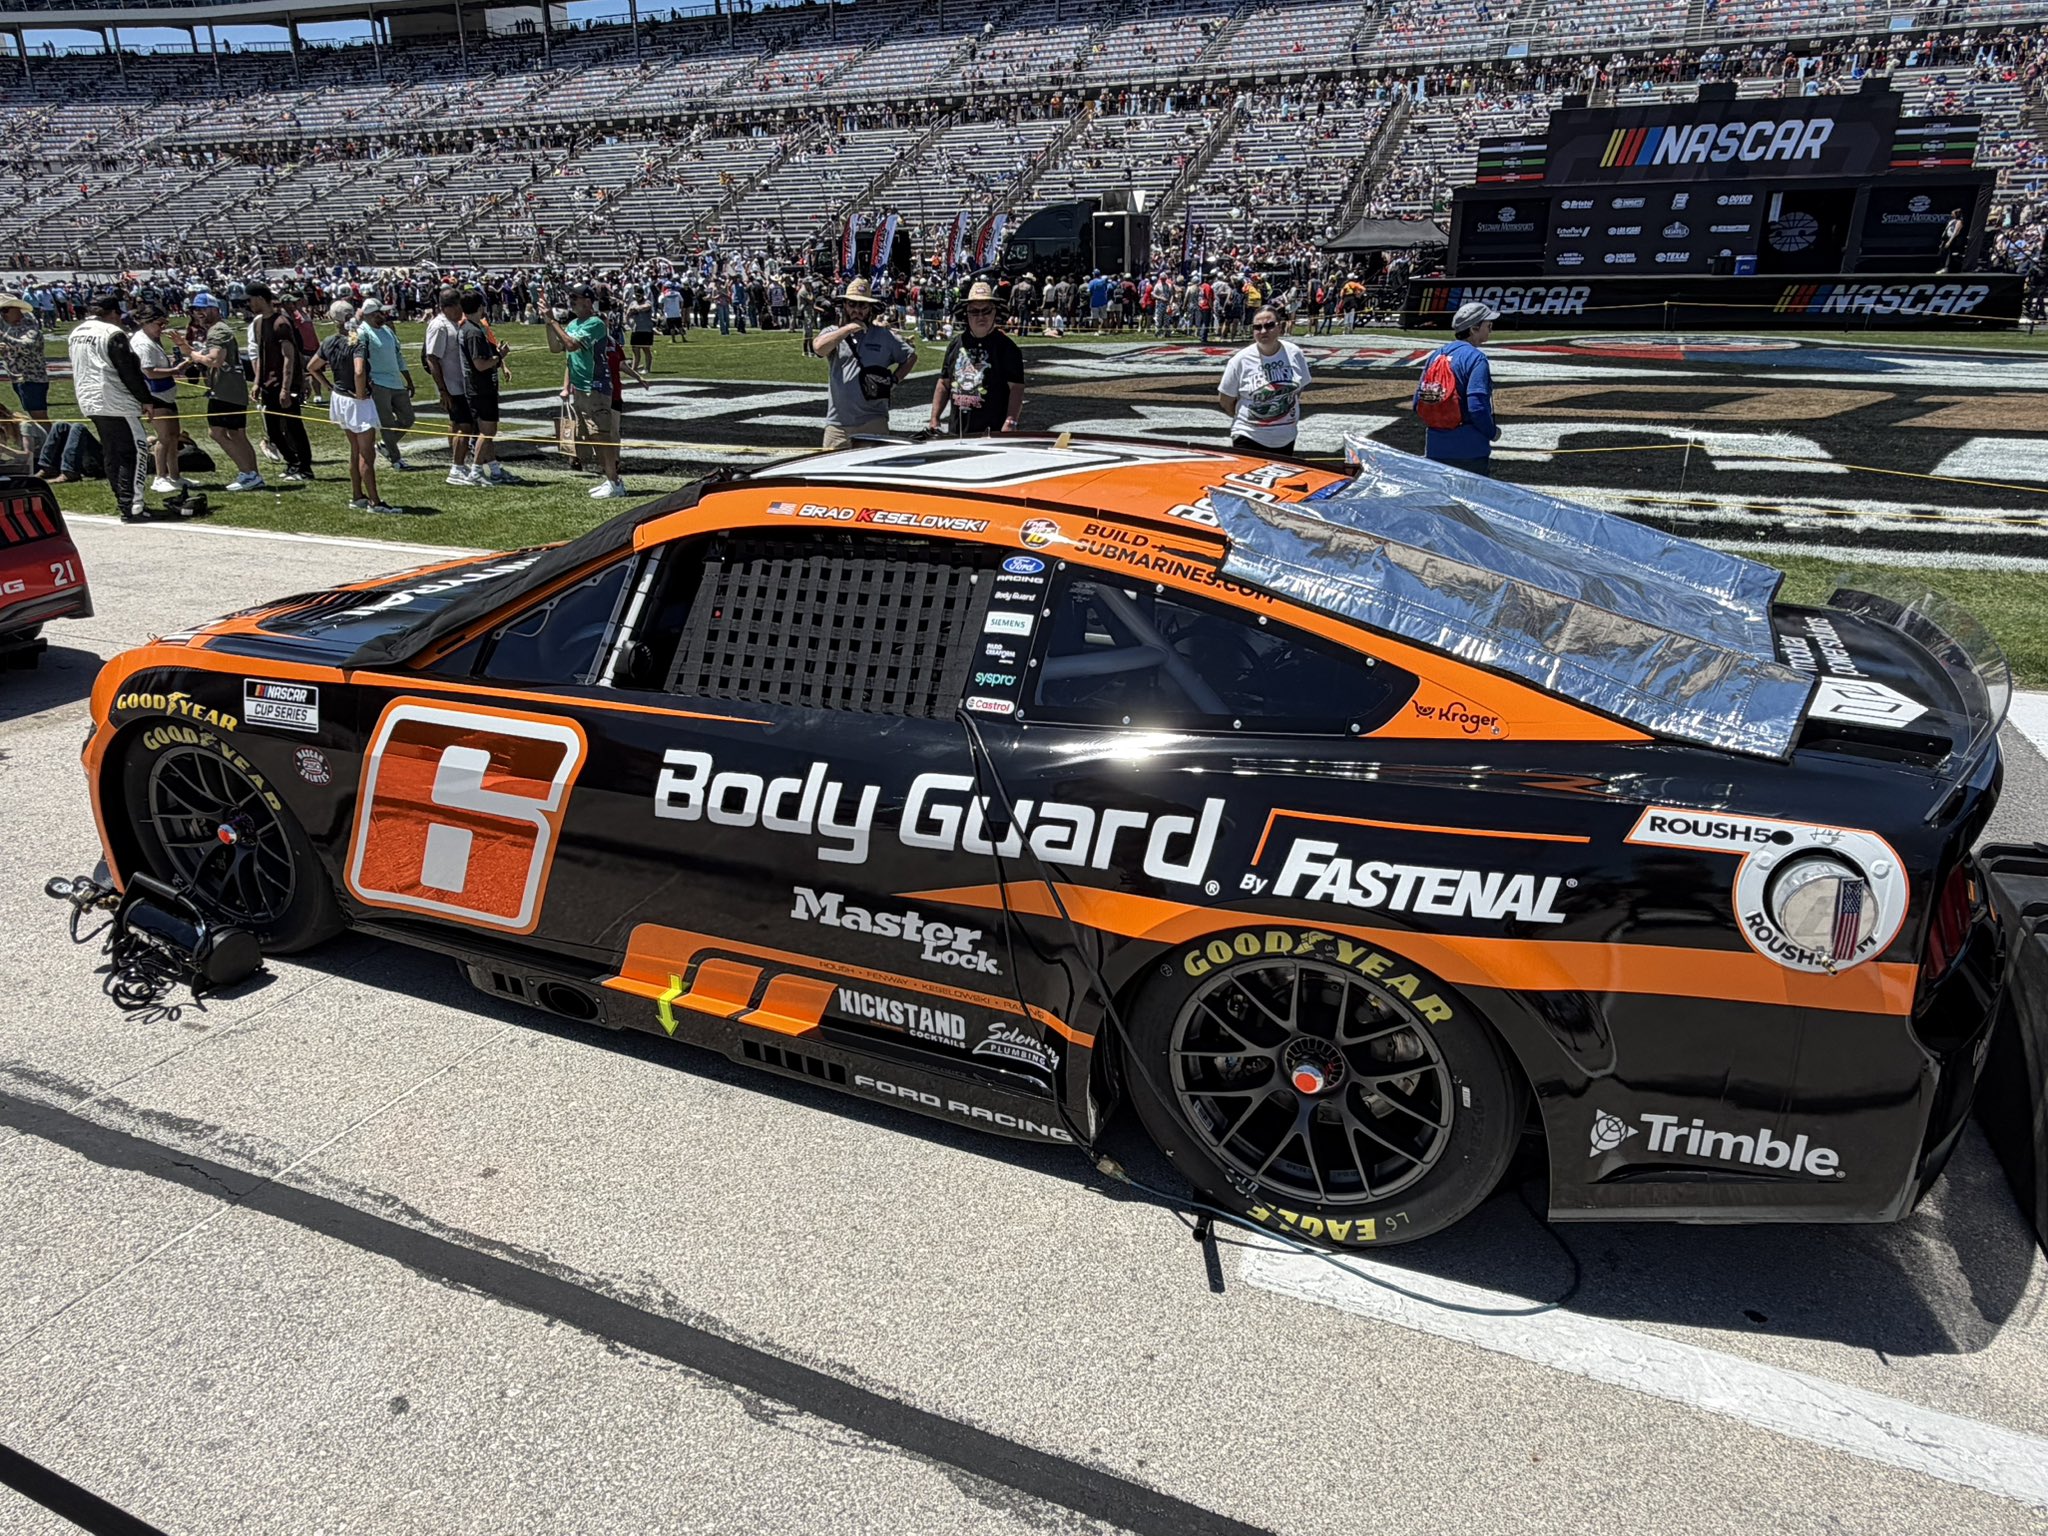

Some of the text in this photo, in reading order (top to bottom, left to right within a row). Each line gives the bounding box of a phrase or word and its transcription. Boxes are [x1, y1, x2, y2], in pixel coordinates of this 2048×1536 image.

[1652, 118, 1835, 165] NASCAR
[1911, 213, 1952, 223] MOTORSPORT
[1460, 286, 1591, 315] NASCAR
[1821, 284, 1990, 315] NASCAR
[797, 504, 991, 533] BRAD KESELOWSKI
[1082, 523, 1150, 547] BUILD
[50, 559, 76, 587] 21
[1007, 557, 1037, 573] Ford
[0, 579, 25, 595] G
[997, 575, 1044, 584] RACING
[990, 618, 1026, 629] SIEMENS
[975, 672, 1015, 687] syspro
[266, 685, 307, 703] NASCAR
[975, 700, 1011, 712] Castrol
[254, 703, 308, 722] CUP SERIES
[1438, 702, 1498, 733] Kroger
[655, 748, 1226, 886] Body Guard
[1239, 838, 1566, 924] By FASTENAL
[790, 886, 982, 953] Master
[921, 939, 999, 975] Lock
[818, 961, 855, 974] ROUSH
[866, 970, 909, 985] FENWAY
[921, 983, 990, 1004] KESELOWSKI
[838, 988, 966, 1041] KICKSTAND
[909, 1029, 966, 1049] COCKTAILS
[990, 1044, 1046, 1066] PLUMBING
[855, 1075, 1074, 1143] FORD RACING
[1640, 1113, 1840, 1177] Trimble
